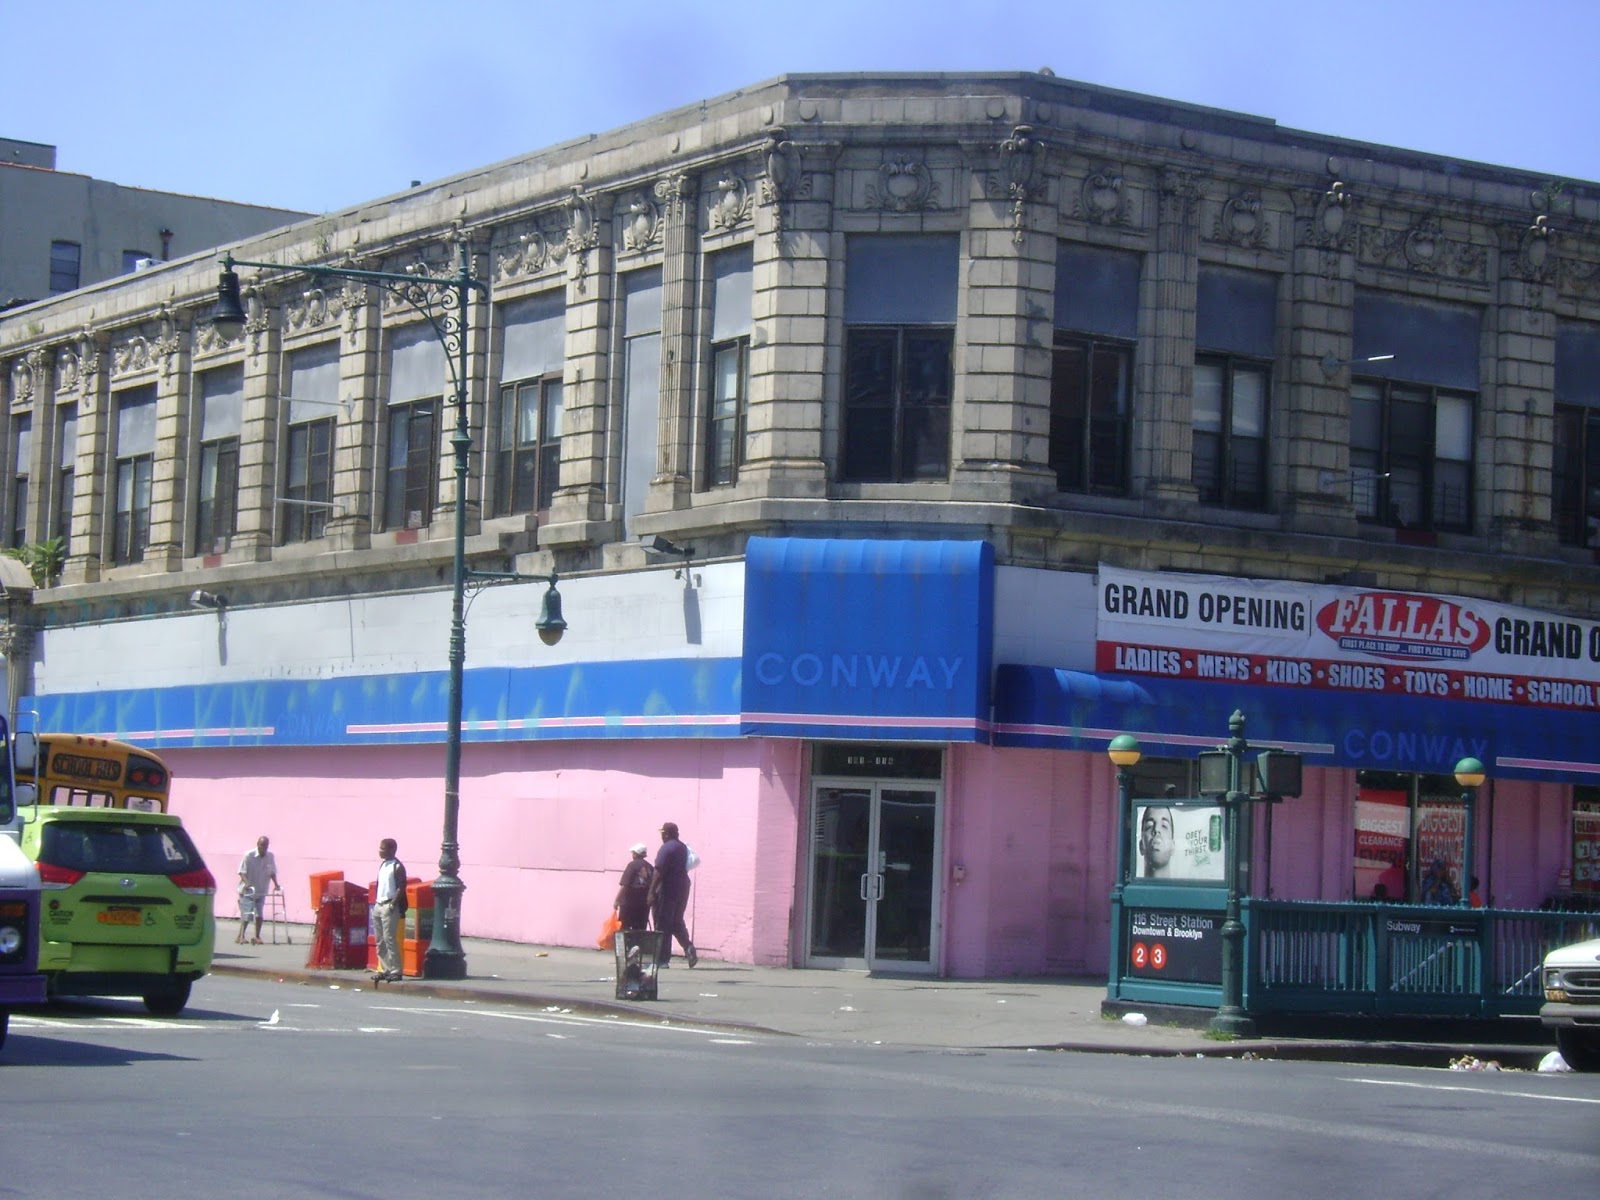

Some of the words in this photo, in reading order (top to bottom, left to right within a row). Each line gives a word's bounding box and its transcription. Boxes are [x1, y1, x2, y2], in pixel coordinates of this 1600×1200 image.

[1105, 583, 1189, 619] GRAND
[1199, 592, 1305, 631] OPENING
[1330, 596, 1483, 645] FALLAS
[1341, 638, 1357, 648] FIRST
[1359, 640, 1376, 650] PLACE
[1377, 642, 1385, 651] TO
[1385, 643, 1400, 652] SHOP
[1408, 644, 1424, 654] FIRST
[1425, 645, 1443, 656] PLACE
[1444, 647, 1451, 656] TO
[1452, 648, 1467, 658] SAVE
[1495, 617, 1582, 660] GRAND
[755, 652, 963, 689] CONWAY
[1115, 646, 1181, 675] LADIES
[1197, 654, 1250, 681] MENS
[1266, 659, 1312, 685] KIDS
[1328, 664, 1385, 690] SHOES
[1403, 670, 1449, 695] TOYS
[1464, 676, 1513, 701] HOME
[1527, 680, 1595, 706] SCHOOL
[1343, 729, 1488, 764] CONWAY
[53, 755, 92, 778] SCHOOL
[97, 759, 121, 780] BUS
[1360, 819, 1404, 833] BIGGEST
[1420, 804, 1464, 832] BIGGEST
[1185, 830, 1202, 840] OBEY
[1190, 836, 1208, 846] YOUR
[1359, 835, 1403, 847] CLEARANCE
[1134, 913, 1147, 926] 116
[1150, 913, 1177, 927] Street
[1181, 915, 1213, 929] Station
[1387, 920, 1421, 934] Subway
[1132, 925, 1165, 937] Downtown
[1167, 927, 1173, 937] &
[1174, 927, 1203, 940] Brooklyn
[1136, 947, 1144, 963] 2
[1154, 948, 1162, 964] 3
